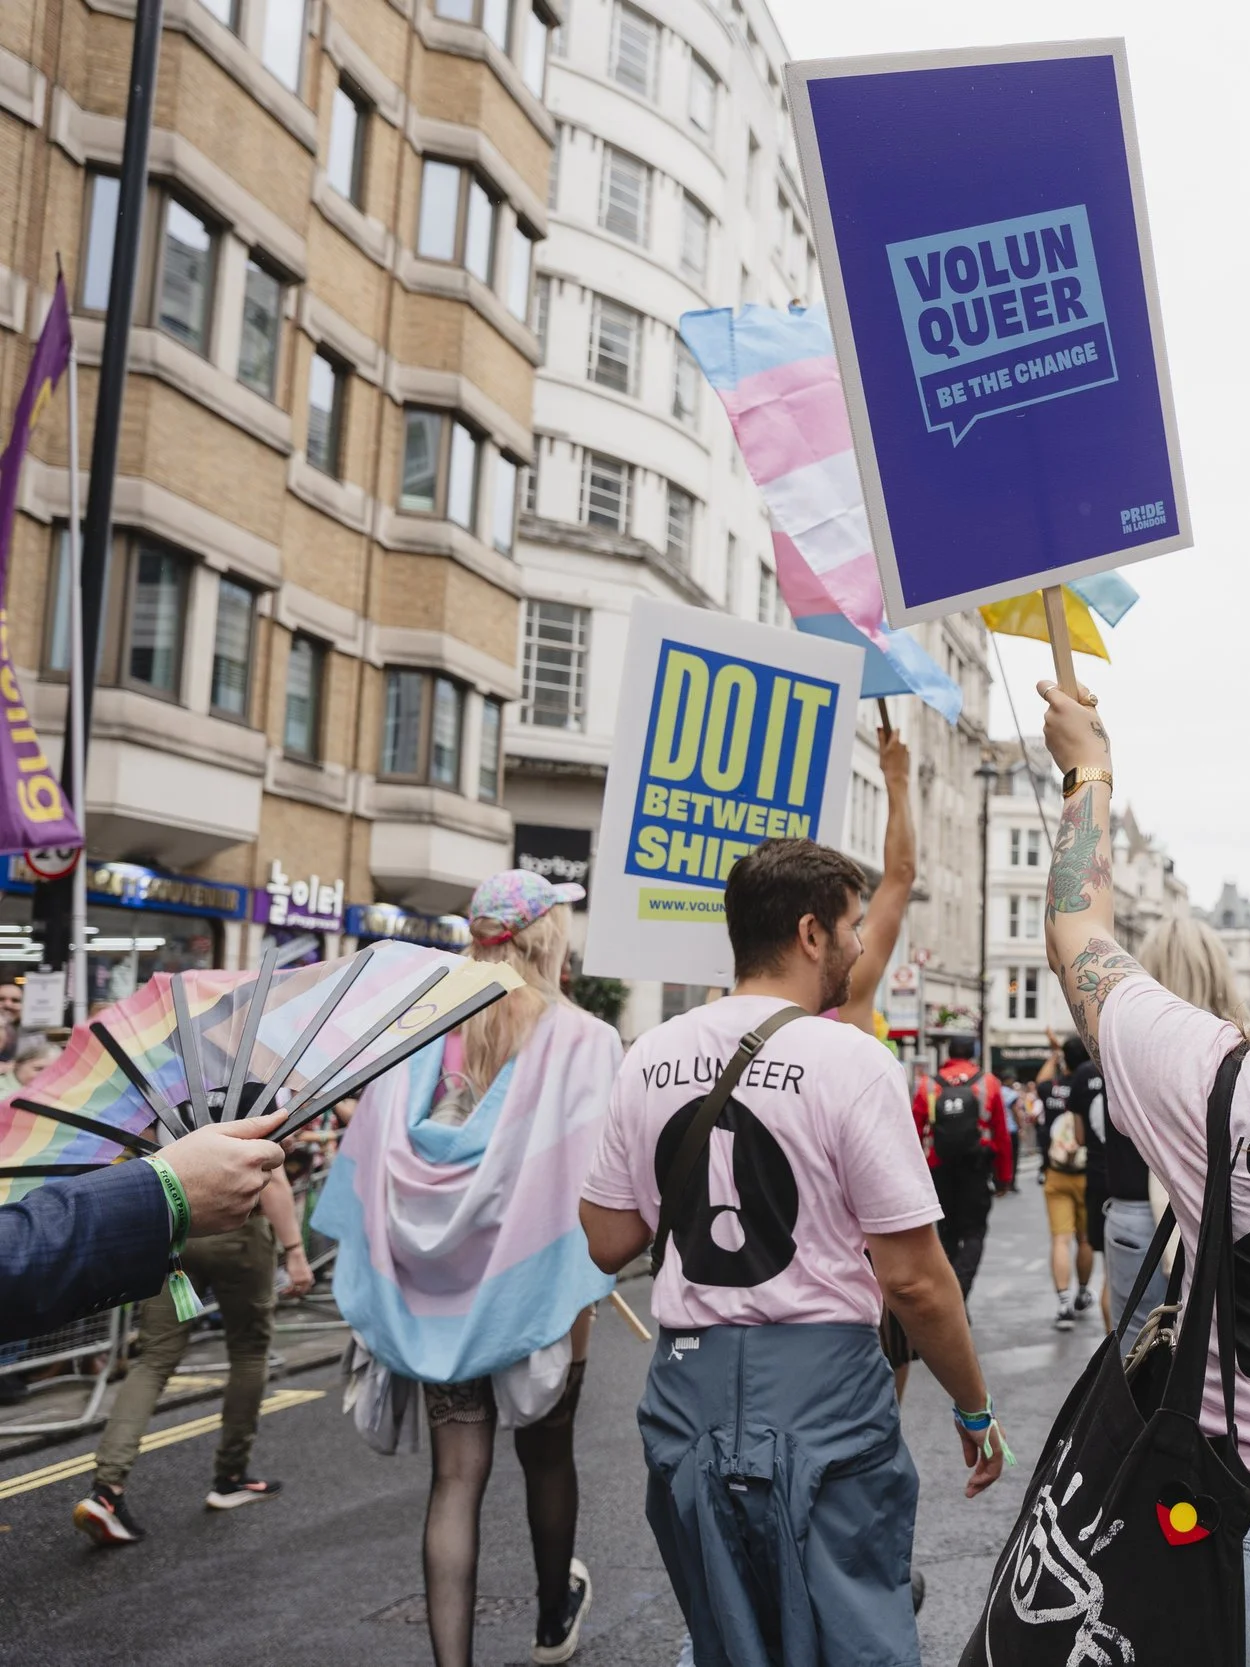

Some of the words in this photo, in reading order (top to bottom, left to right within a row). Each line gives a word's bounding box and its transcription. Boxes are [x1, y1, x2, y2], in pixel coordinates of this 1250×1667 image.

[904, 223, 1079, 303] VOLUN
[918, 276, 1089, 360] QUEER
[936, 384, 967, 409] BE
[968, 369, 1012, 398] THE
[1014, 341, 1098, 384] CHANGE
[1122, 524, 1132, 534] IN
[1132, 516, 1166, 532] LONDON
[649, 648, 757, 792] DO
[756, 675, 832, 807] IT
[642, 783, 811, 839] BETWEEN
[635, 824, 757, 882] SHIF
[266, 859, 344, 925] 놀이터
[649, 899, 727, 913] WWW.VOLUN
[642, 1056, 805, 1094] VOLUNEER
[160, 1169, 177, 1193] Front
[171, 1192, 181, 1203] of
